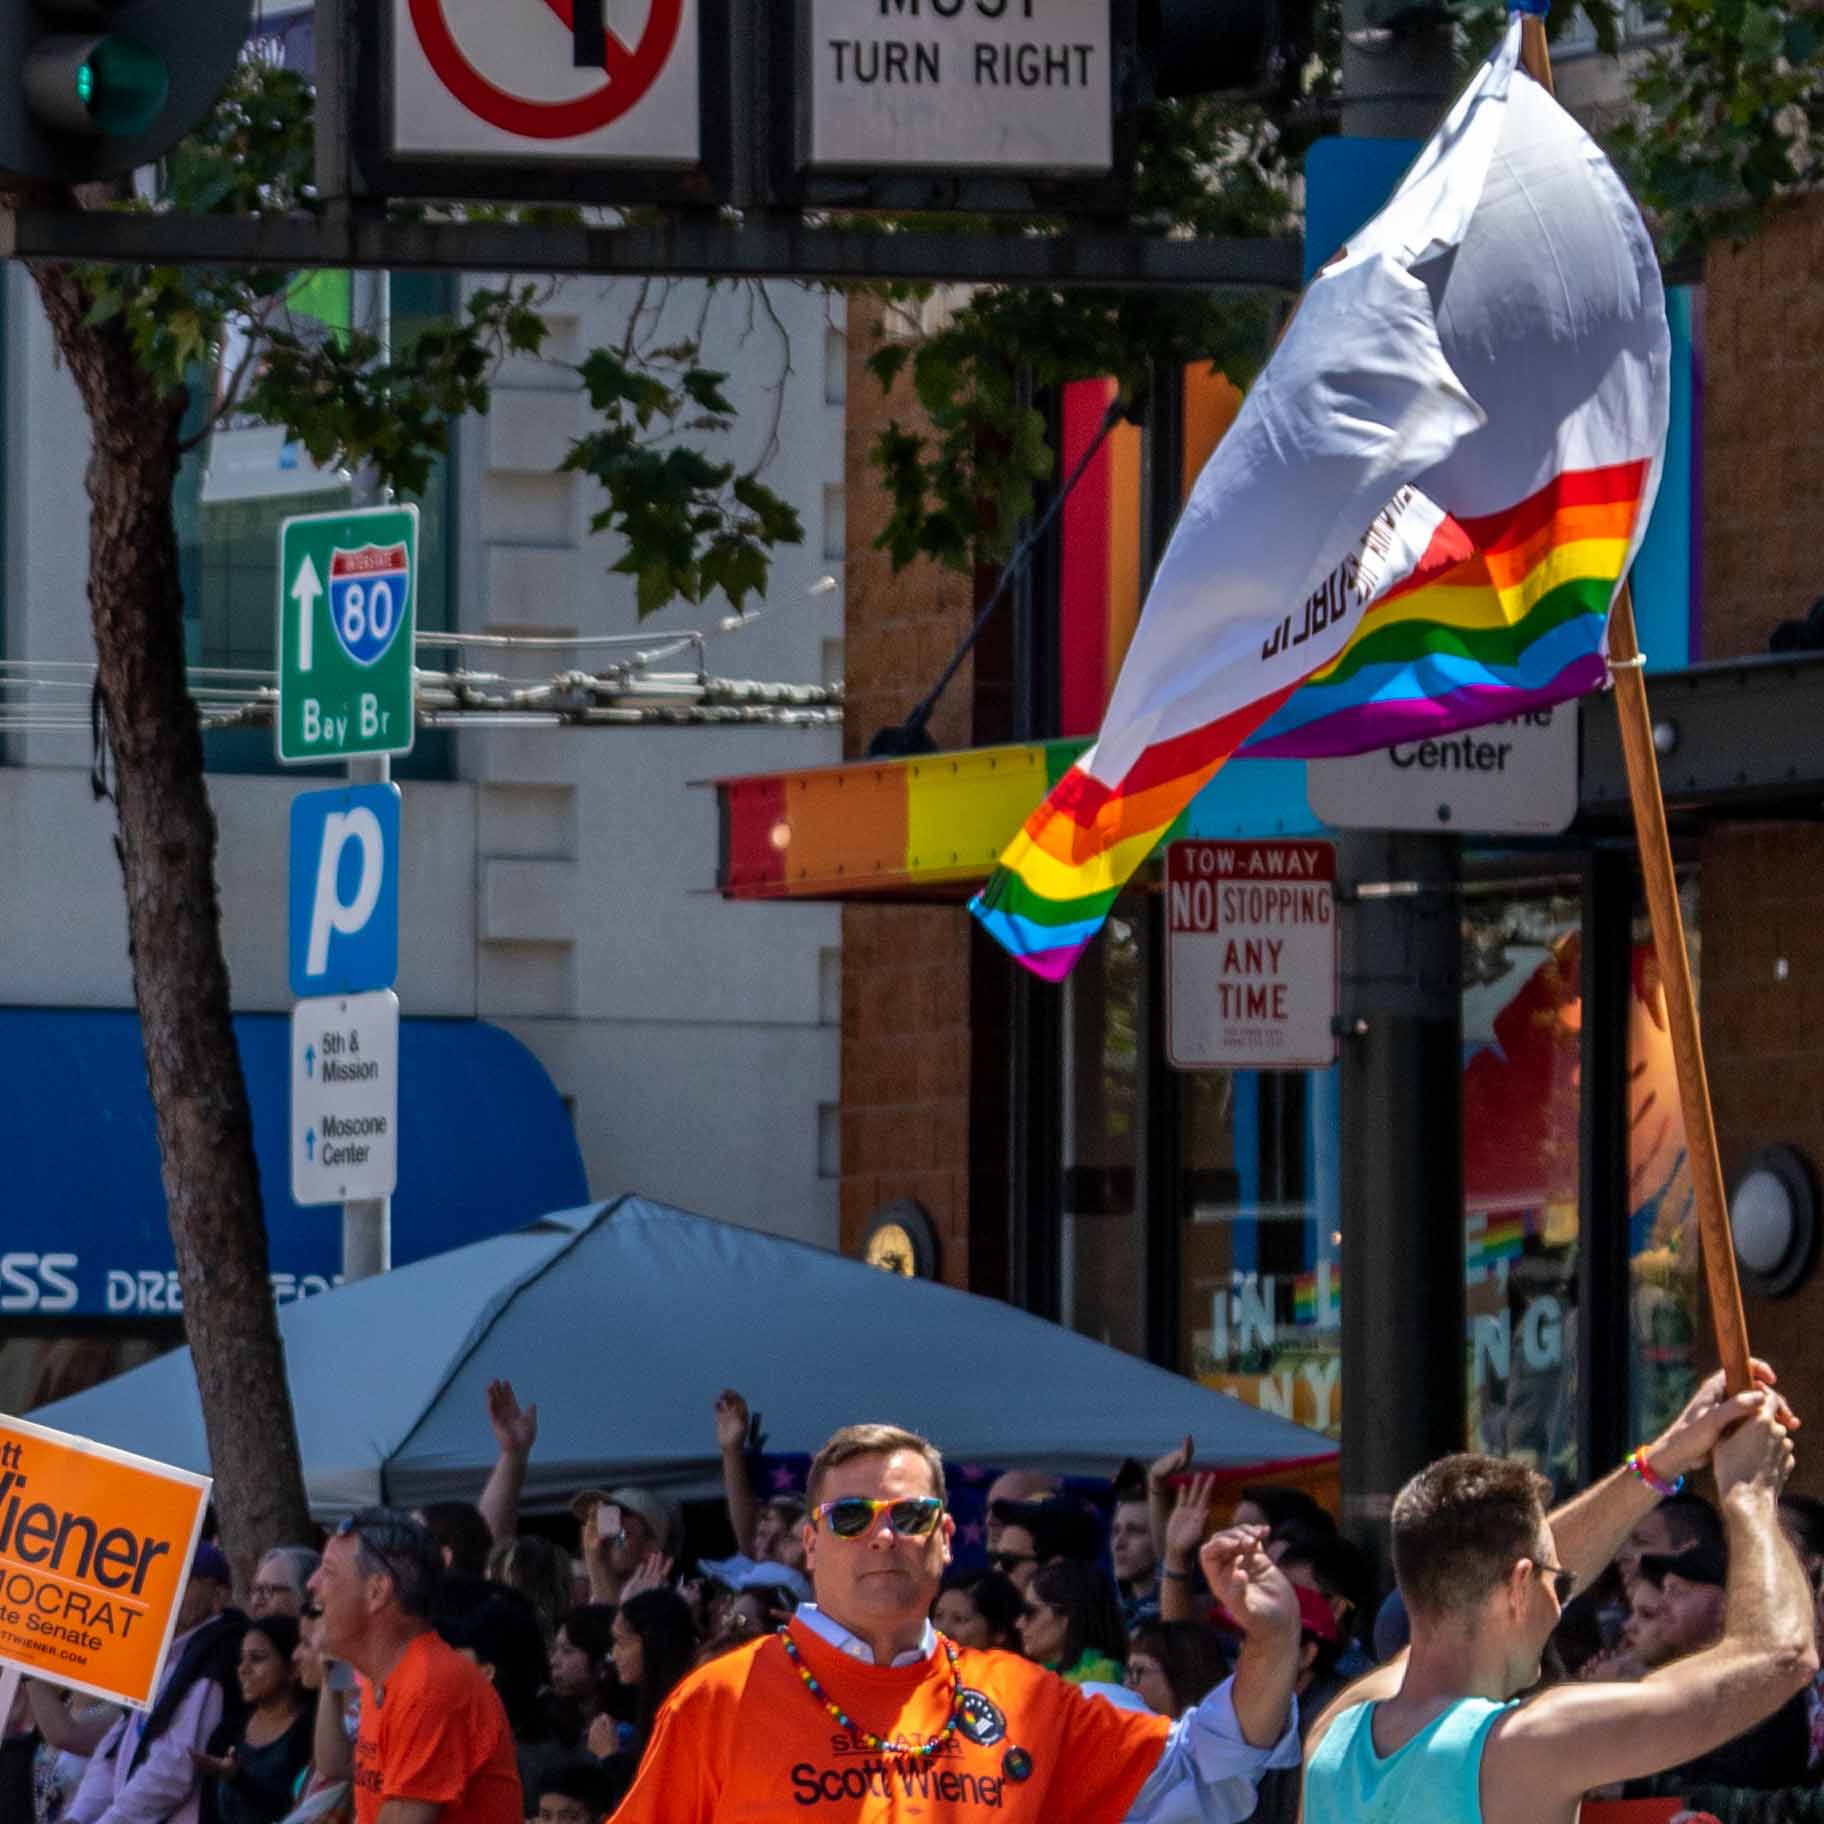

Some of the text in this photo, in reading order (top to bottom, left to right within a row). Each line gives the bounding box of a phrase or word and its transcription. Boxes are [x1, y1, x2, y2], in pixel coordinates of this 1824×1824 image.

[828, 40, 1095, 87] TURN RIGHT
[343, 579, 393, 643] 80
[303, 692, 390, 747] Bay Br
[1388, 735, 1512, 771] Center
[1186, 847, 1320, 875] TOW-AWAY
[1171, 880, 1331, 928] NO STOPPING
[1223, 938, 1284, 975] ANY
[1218, 983, 1290, 1020] TIME
[322, 1029, 360, 1055] 5th &
[322, 1060, 380, 1082] Mission
[322, 1115, 388, 1138] Moscone
[322, 1141, 370, 1168] Center
[108, 1270, 184, 1312] DRE
[25, 1612, 103, 1651] Senate
[791, 1757, 1006, 1808] Scott Wiener
